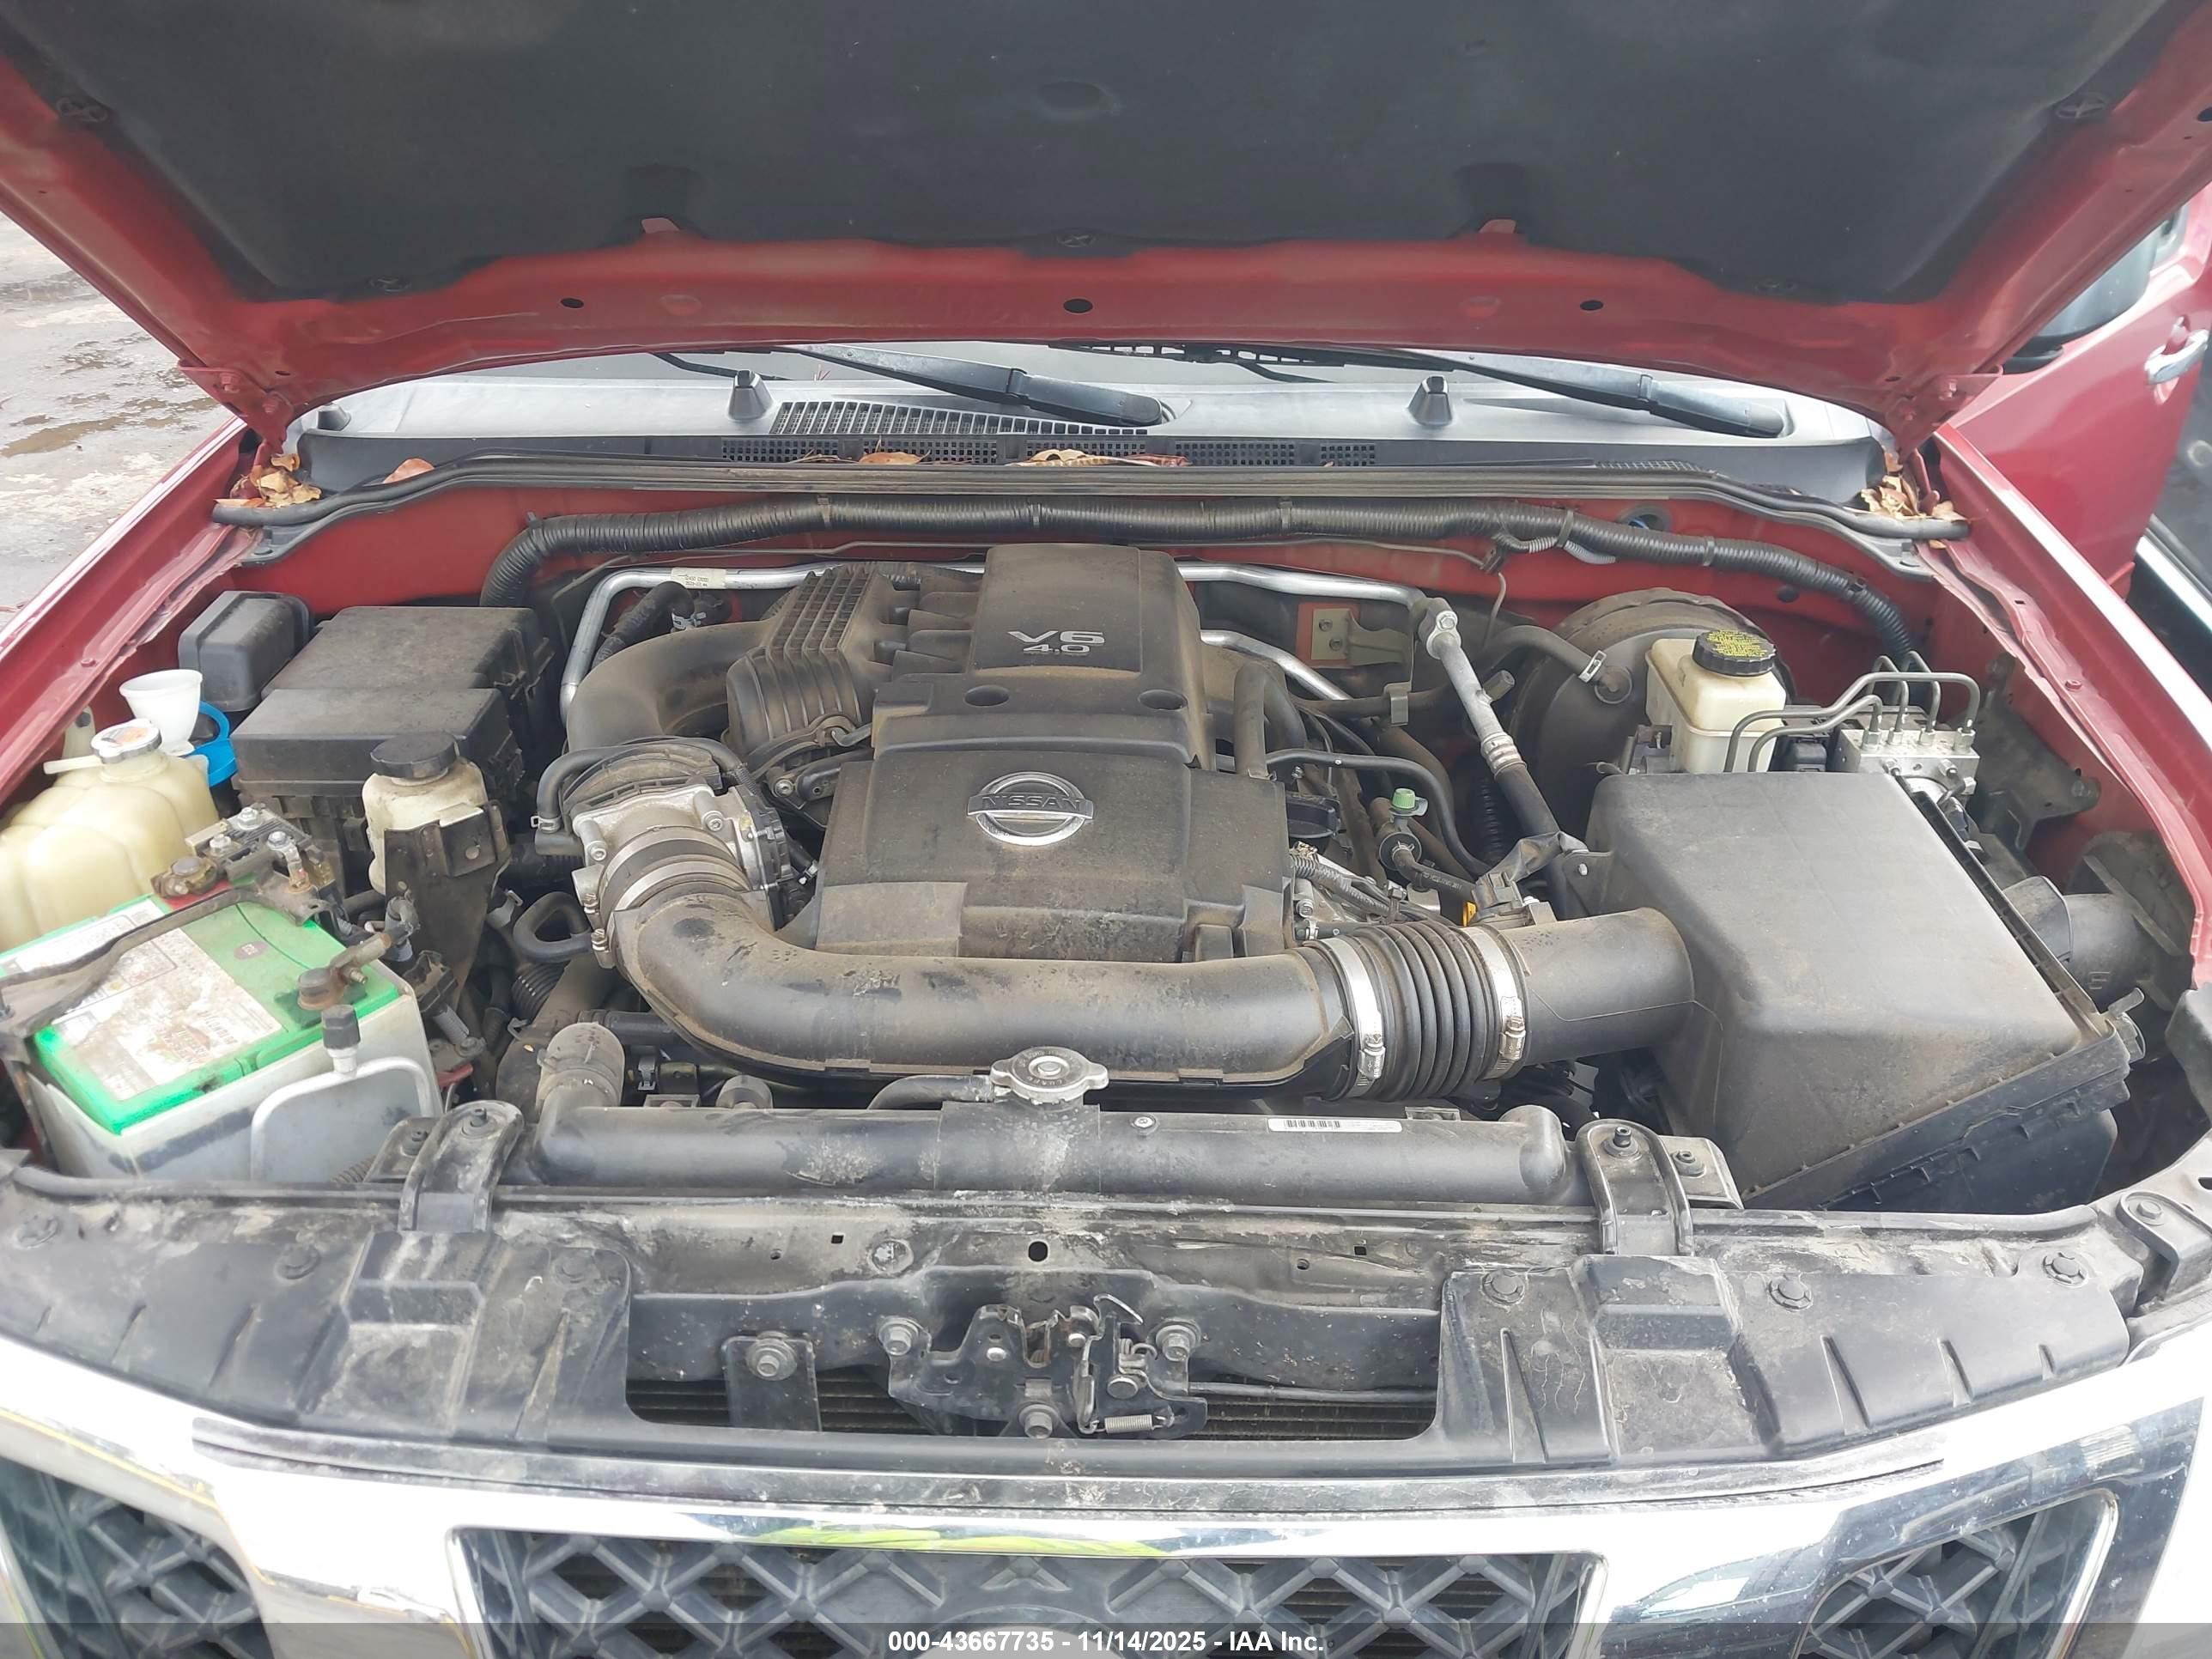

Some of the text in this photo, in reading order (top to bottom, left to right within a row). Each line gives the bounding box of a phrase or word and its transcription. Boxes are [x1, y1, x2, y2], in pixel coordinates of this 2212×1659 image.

[1006, 629, 1106, 645] V6
[1022, 643, 1091, 655] 4.0
[981, 794, 1083, 811] NISSAN
